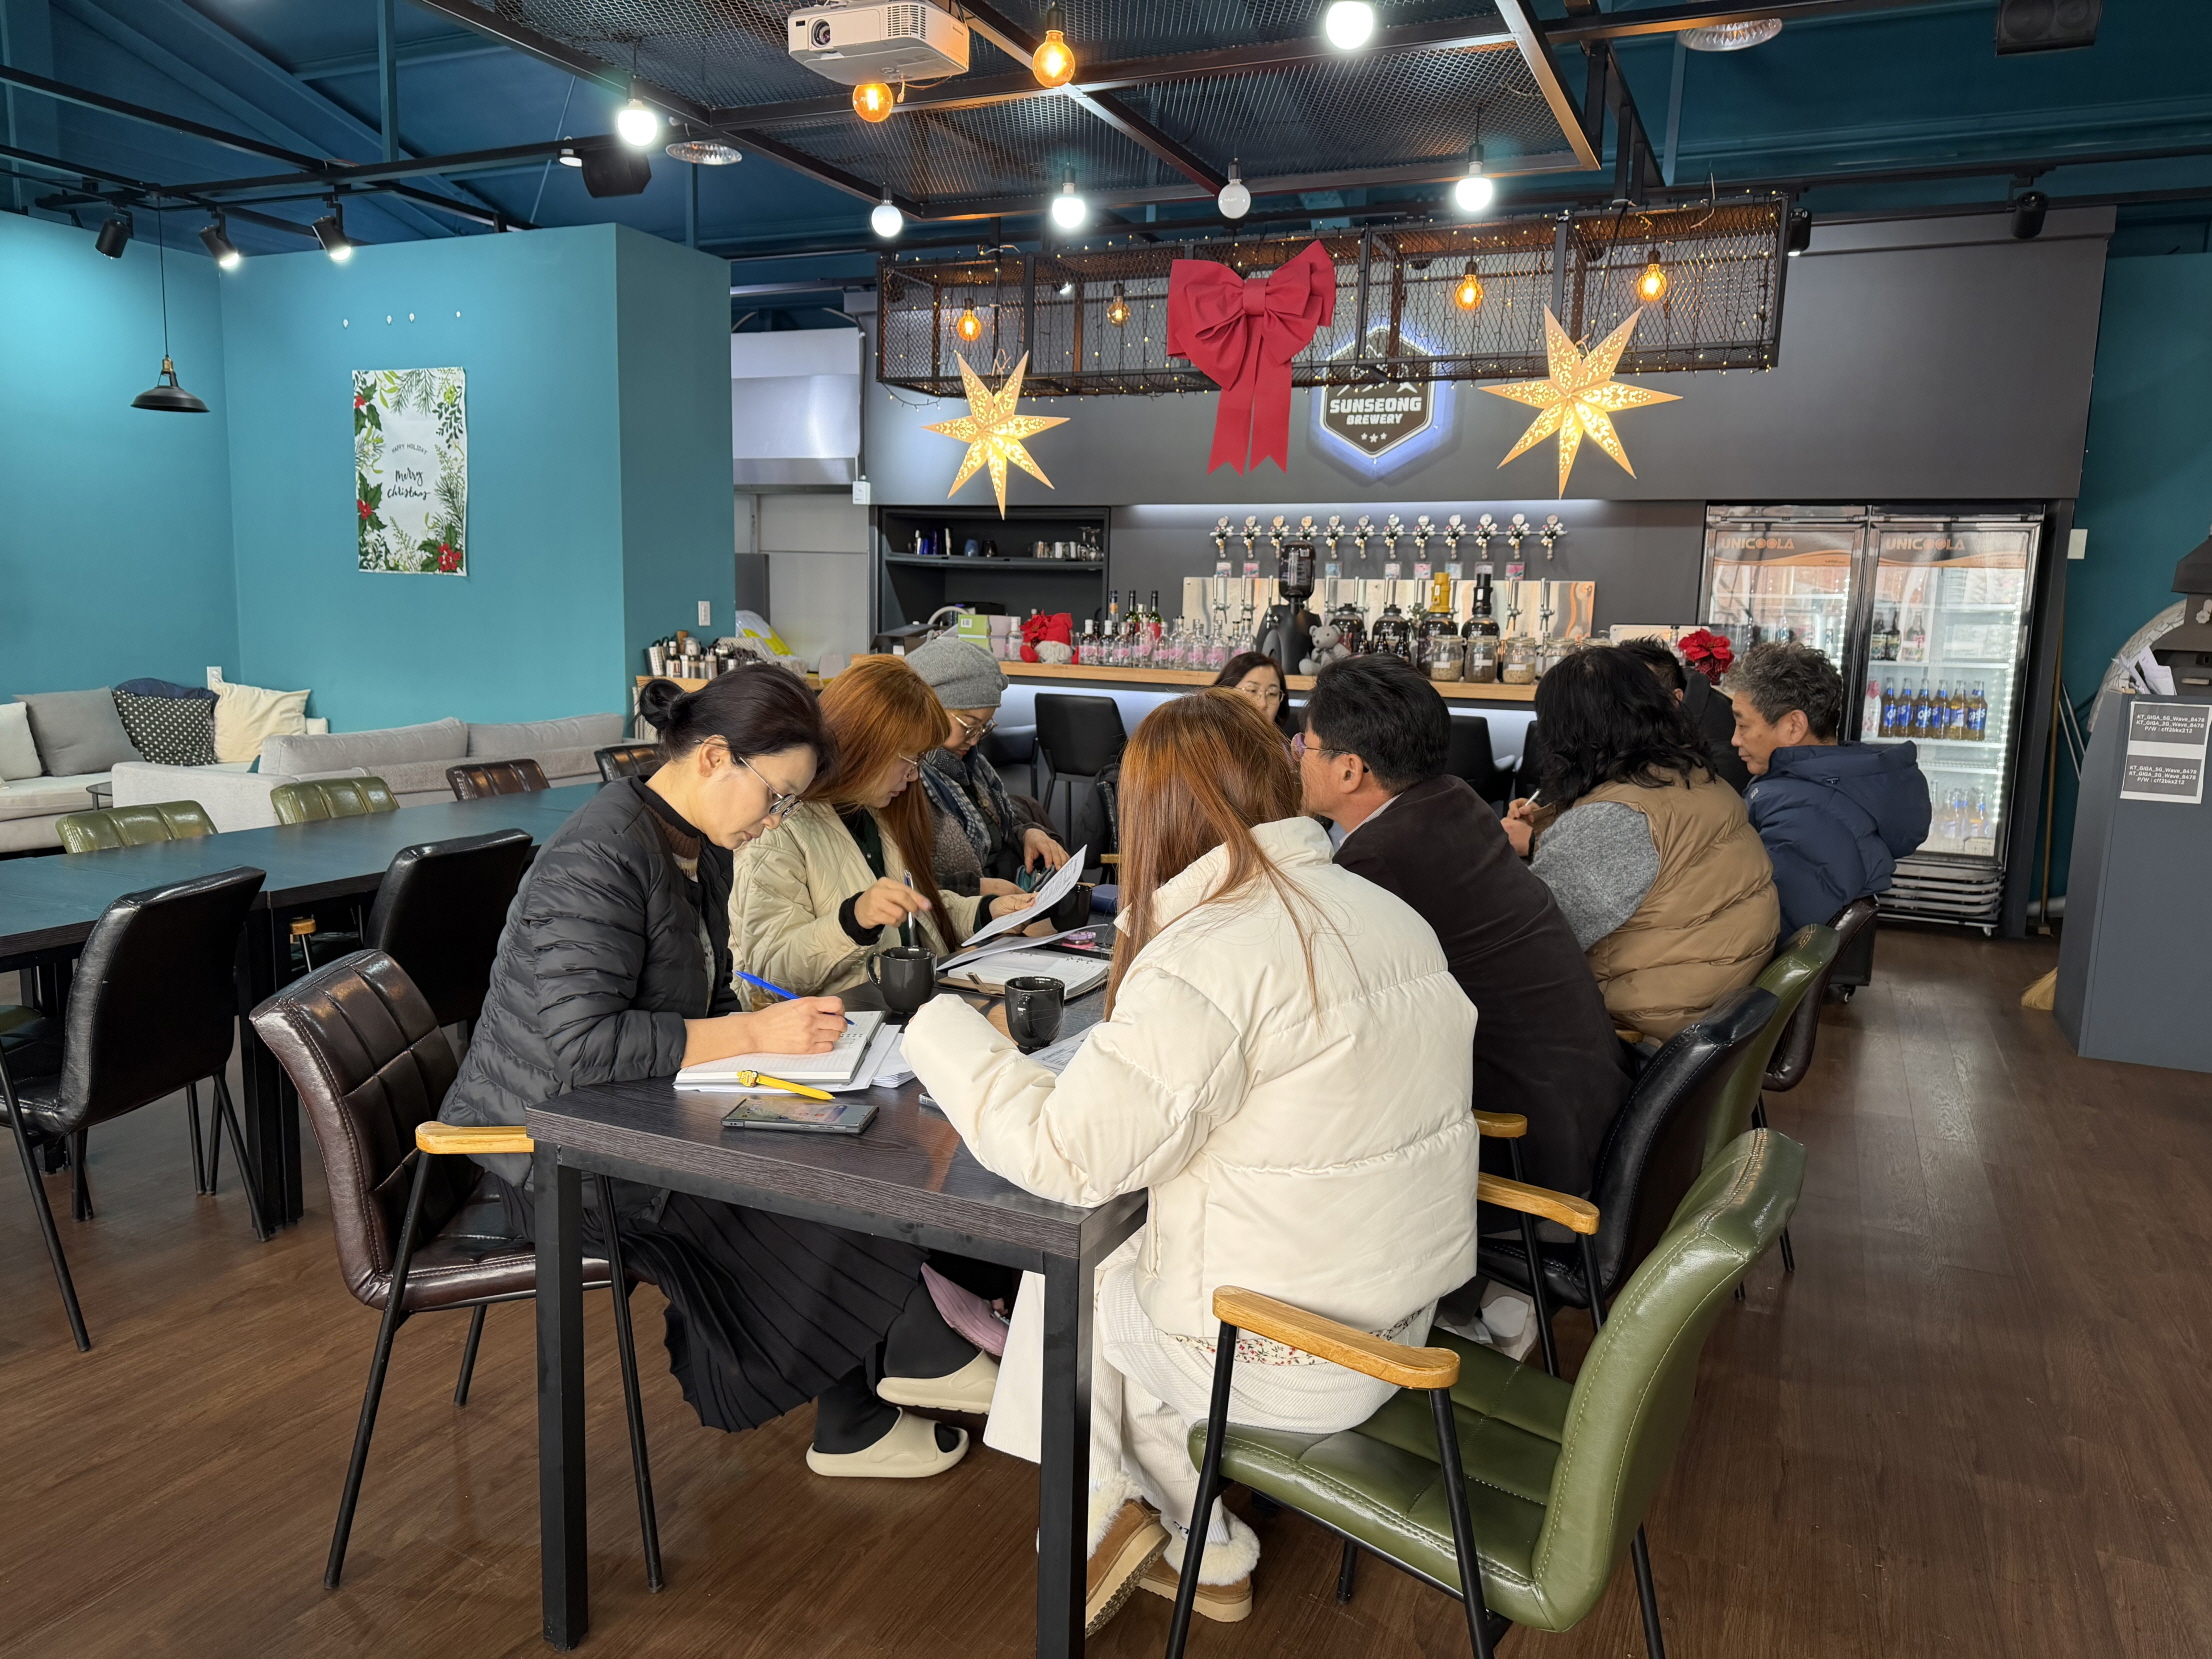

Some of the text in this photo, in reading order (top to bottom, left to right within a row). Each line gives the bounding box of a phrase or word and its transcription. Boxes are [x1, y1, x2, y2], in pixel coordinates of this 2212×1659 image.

[1330, 397, 1422, 413] SUNSEONG
[1347, 414, 1403, 425] BREWERY
[392, 443, 427, 454] HAPPY HOLIDAY
[395, 467, 424, 487] Merry
[1721, 537, 1795, 550] UNICOOLA
[1885, 537, 1966, 551] UNICOOLA
